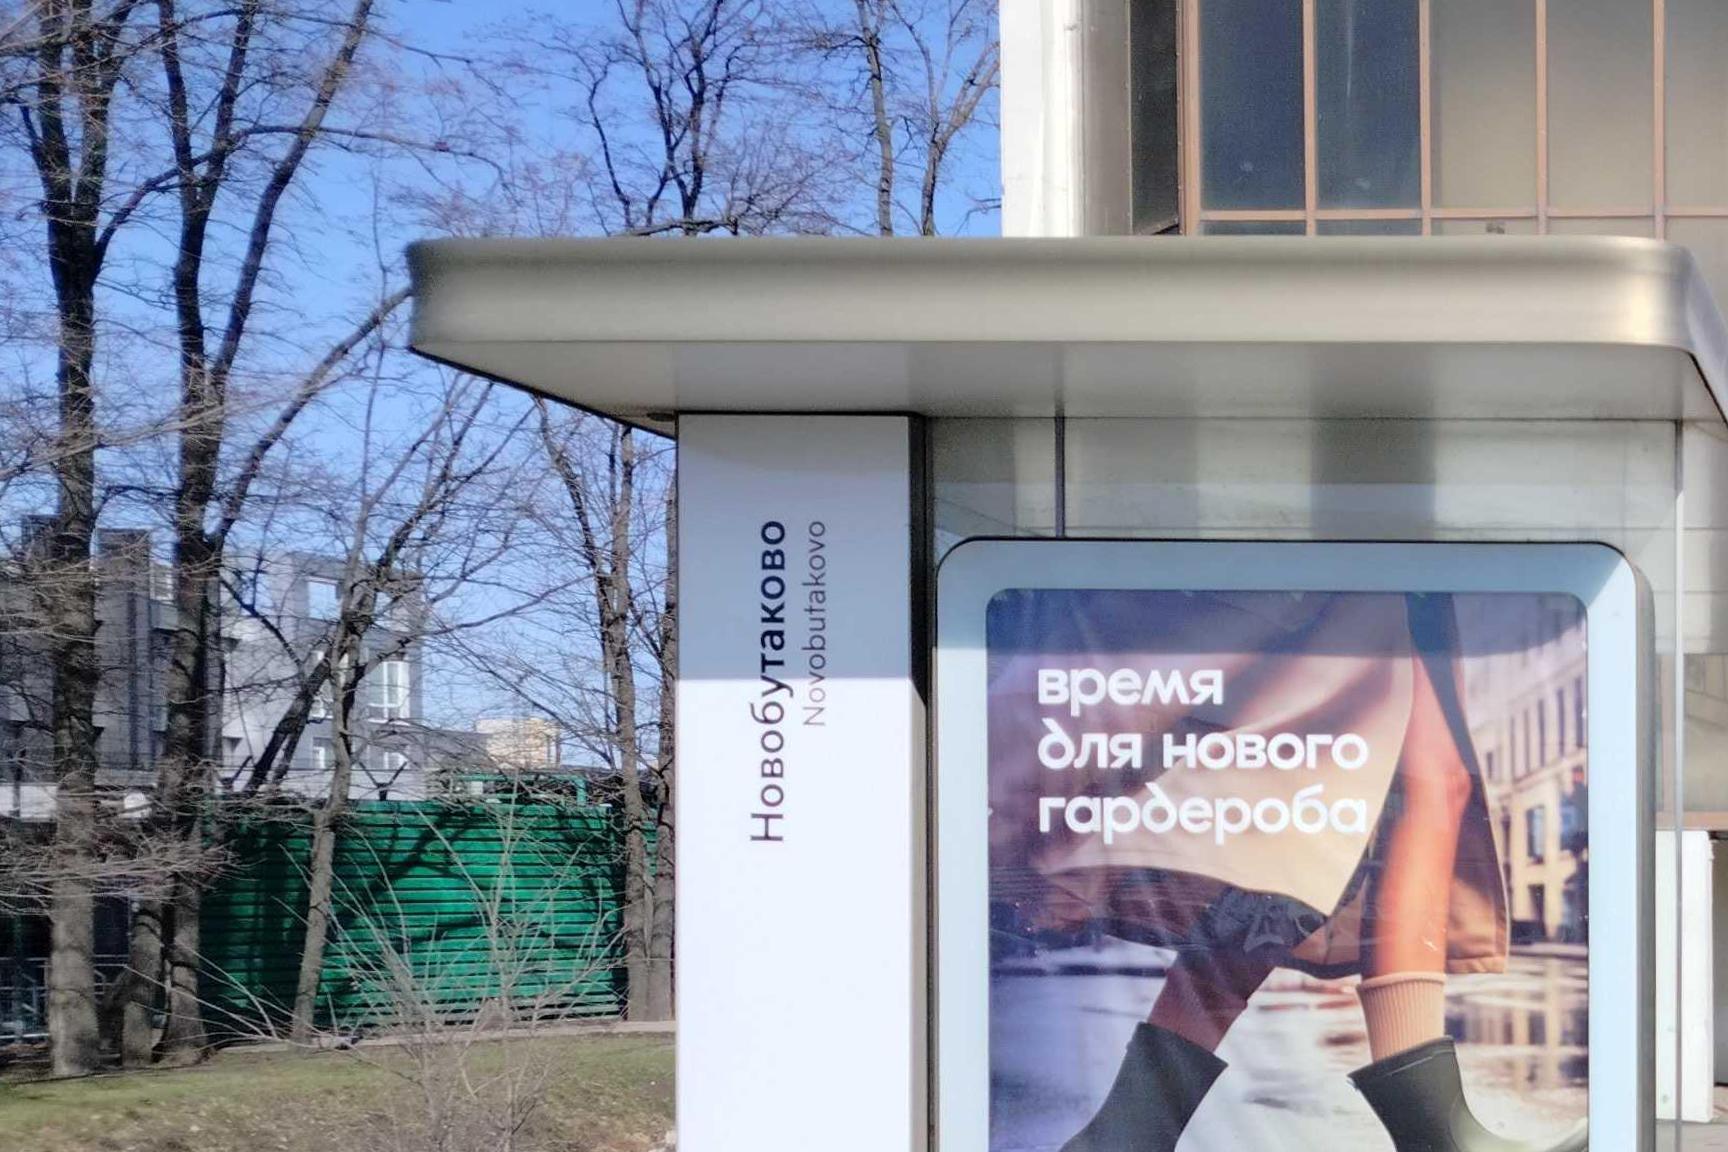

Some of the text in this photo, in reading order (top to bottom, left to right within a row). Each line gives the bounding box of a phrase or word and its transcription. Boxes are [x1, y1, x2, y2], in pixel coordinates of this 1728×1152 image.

[802, 520, 827, 727] Novobutakovo
[750, 519, 794, 842] Новобутаково
[1038, 668, 1225, 717] время
[1037, 717, 1370, 770] для нового
[1039, 782, 1368, 846] гардероба
